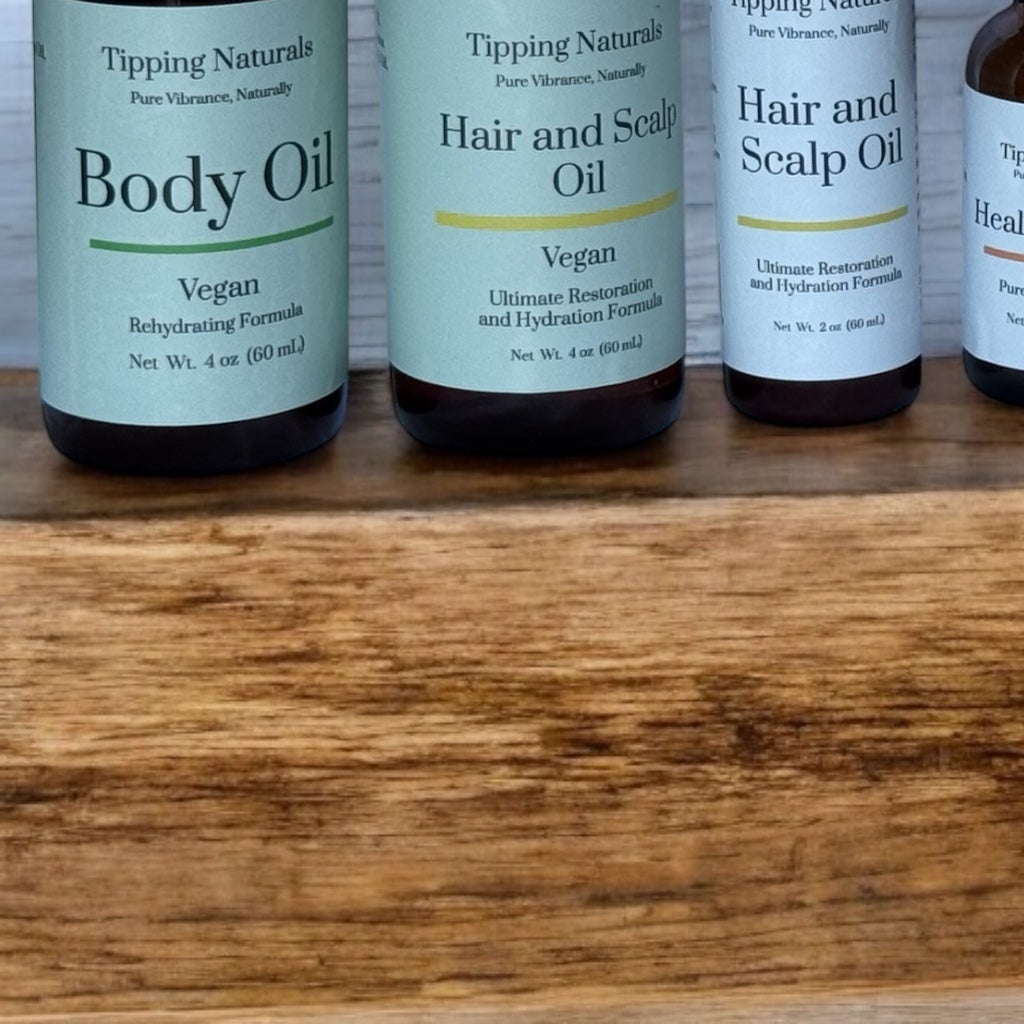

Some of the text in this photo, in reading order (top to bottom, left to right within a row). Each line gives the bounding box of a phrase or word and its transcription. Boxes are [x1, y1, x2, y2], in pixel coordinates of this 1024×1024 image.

[466, 19, 663, 64] Tipping Naturals
[749, 19, 890, 40] Pure Vibrance, Naturally
[101, 36, 313, 79] Tipping Naturals
[495, 62, 647, 89] Pure Vibrance, Naturally
[130, 81, 293, 105] Pure Vibrance, Naturally
[737, 84, 821, 127] Hair
[832, 78, 898, 124] and
[440, 112, 522, 152] Hair
[532, 113, 604, 151] and
[614, 98, 677, 145] Scalp
[742, 127, 903, 186] Scalp Oil
[75, 130, 334, 231] Body Oil
[553, 160, 606, 197] Oil
[541, 242, 616, 272] Vegan
[757, 252, 894, 275] Ultimate Restoration
[178, 275, 259, 305] Vegan
[489, 276, 653, 306] Ultimate Restoration
[750, 268, 903, 295] and Hydration Formula
[129, 302, 303, 338] Rehydrating Formula
[479, 293, 663, 331] and Hydration Formula
[773, 320, 791, 333] Net
[819, 321, 828, 333] 2
[829, 323, 842, 333] oz
[1006, 313, 1024, 327] Net
[129, 353, 158, 370] Net
[204, 353, 215, 368] 4
[220, 353, 239, 367] oz
[510, 348, 534, 362] Net
[568, 346, 578, 360] 4
[579, 347, 594, 358] oz
